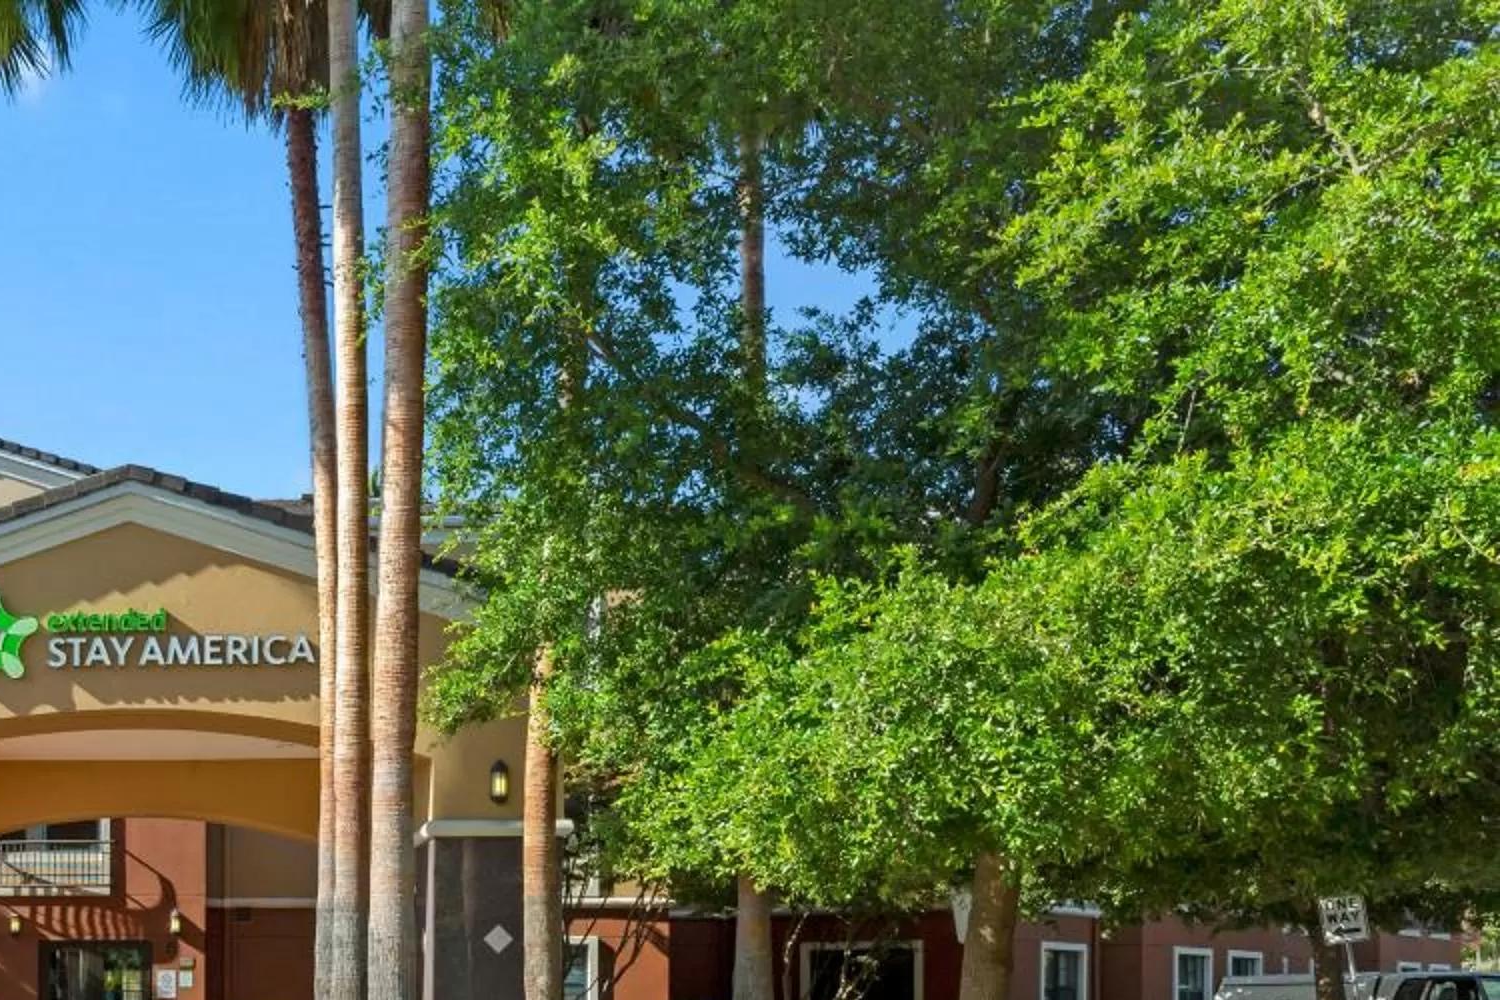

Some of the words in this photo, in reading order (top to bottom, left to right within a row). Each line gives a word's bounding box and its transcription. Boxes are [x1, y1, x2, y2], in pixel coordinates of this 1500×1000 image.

[46, 608, 166, 633] extended
[47, 635, 136, 668] STAY
[139, 633, 315, 667] AMERICA
[1326, 897, 1359, 910] ONE
[1327, 911, 1360, 922] WAY
